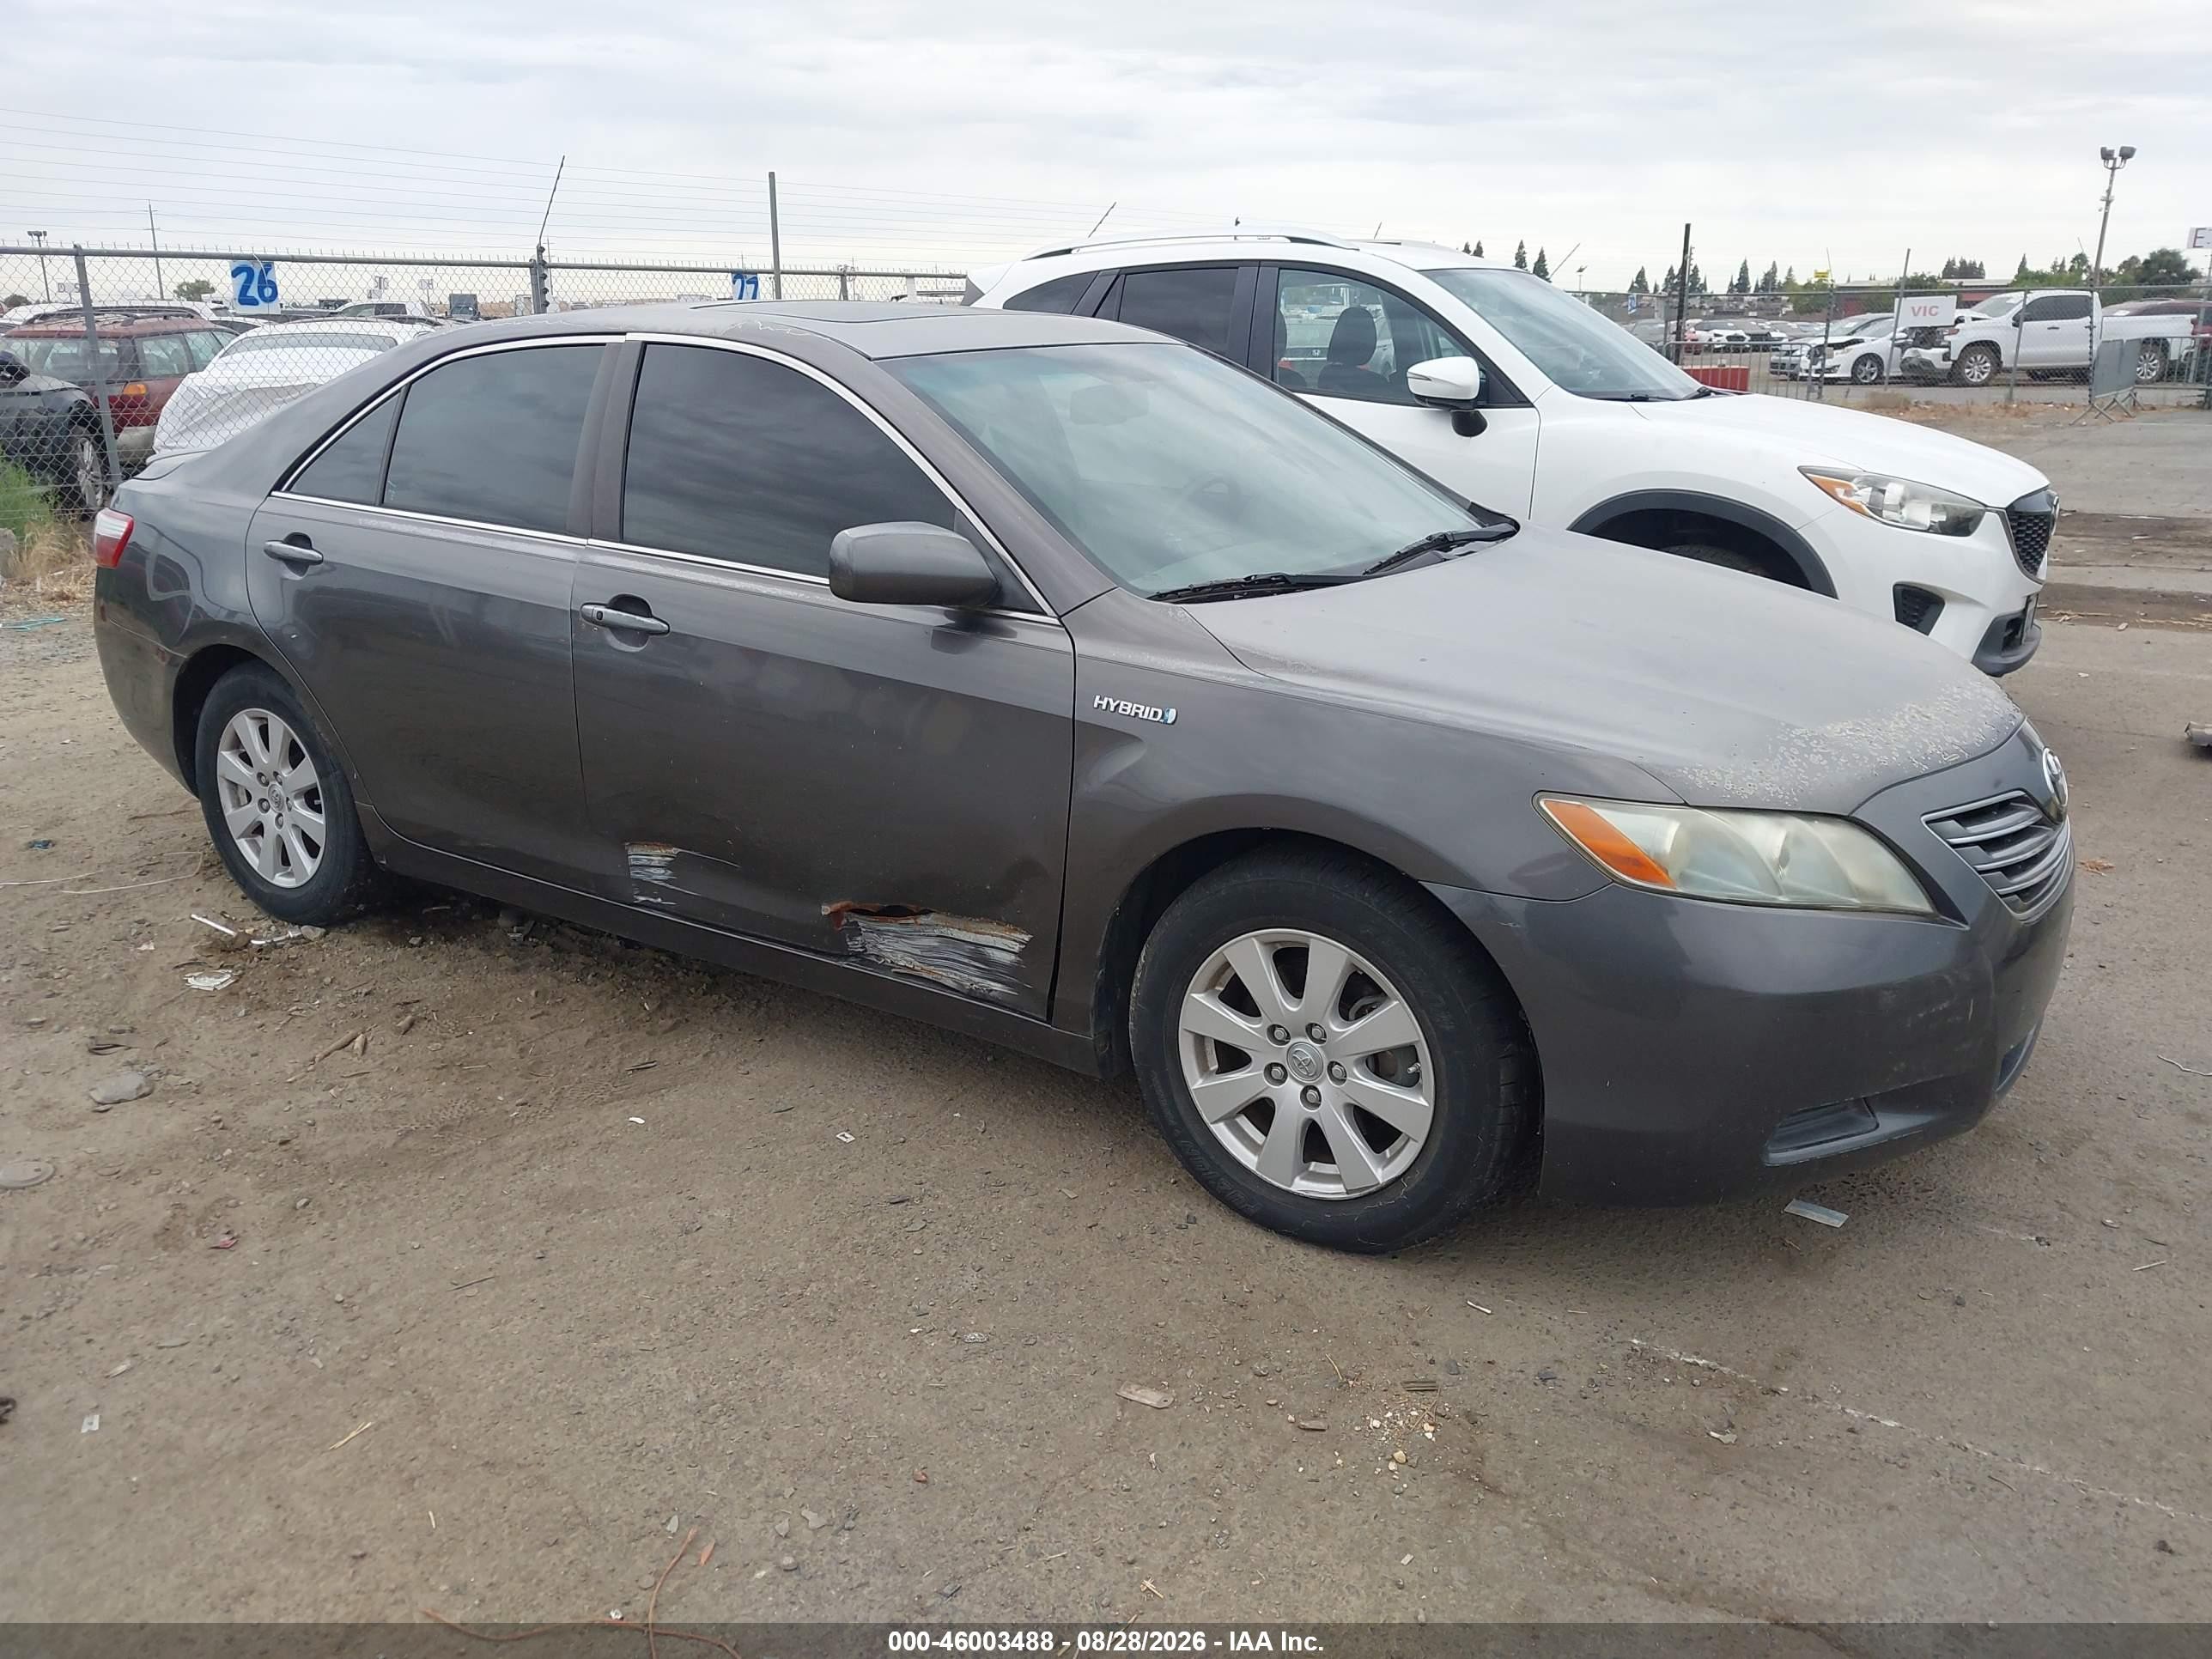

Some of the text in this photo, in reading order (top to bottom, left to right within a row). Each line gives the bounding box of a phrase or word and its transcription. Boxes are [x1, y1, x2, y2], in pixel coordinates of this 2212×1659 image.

[231, 264, 278, 307] 26
[1911, 305, 1939, 317] VIC
[1093, 695, 1163, 723] HYBRID
